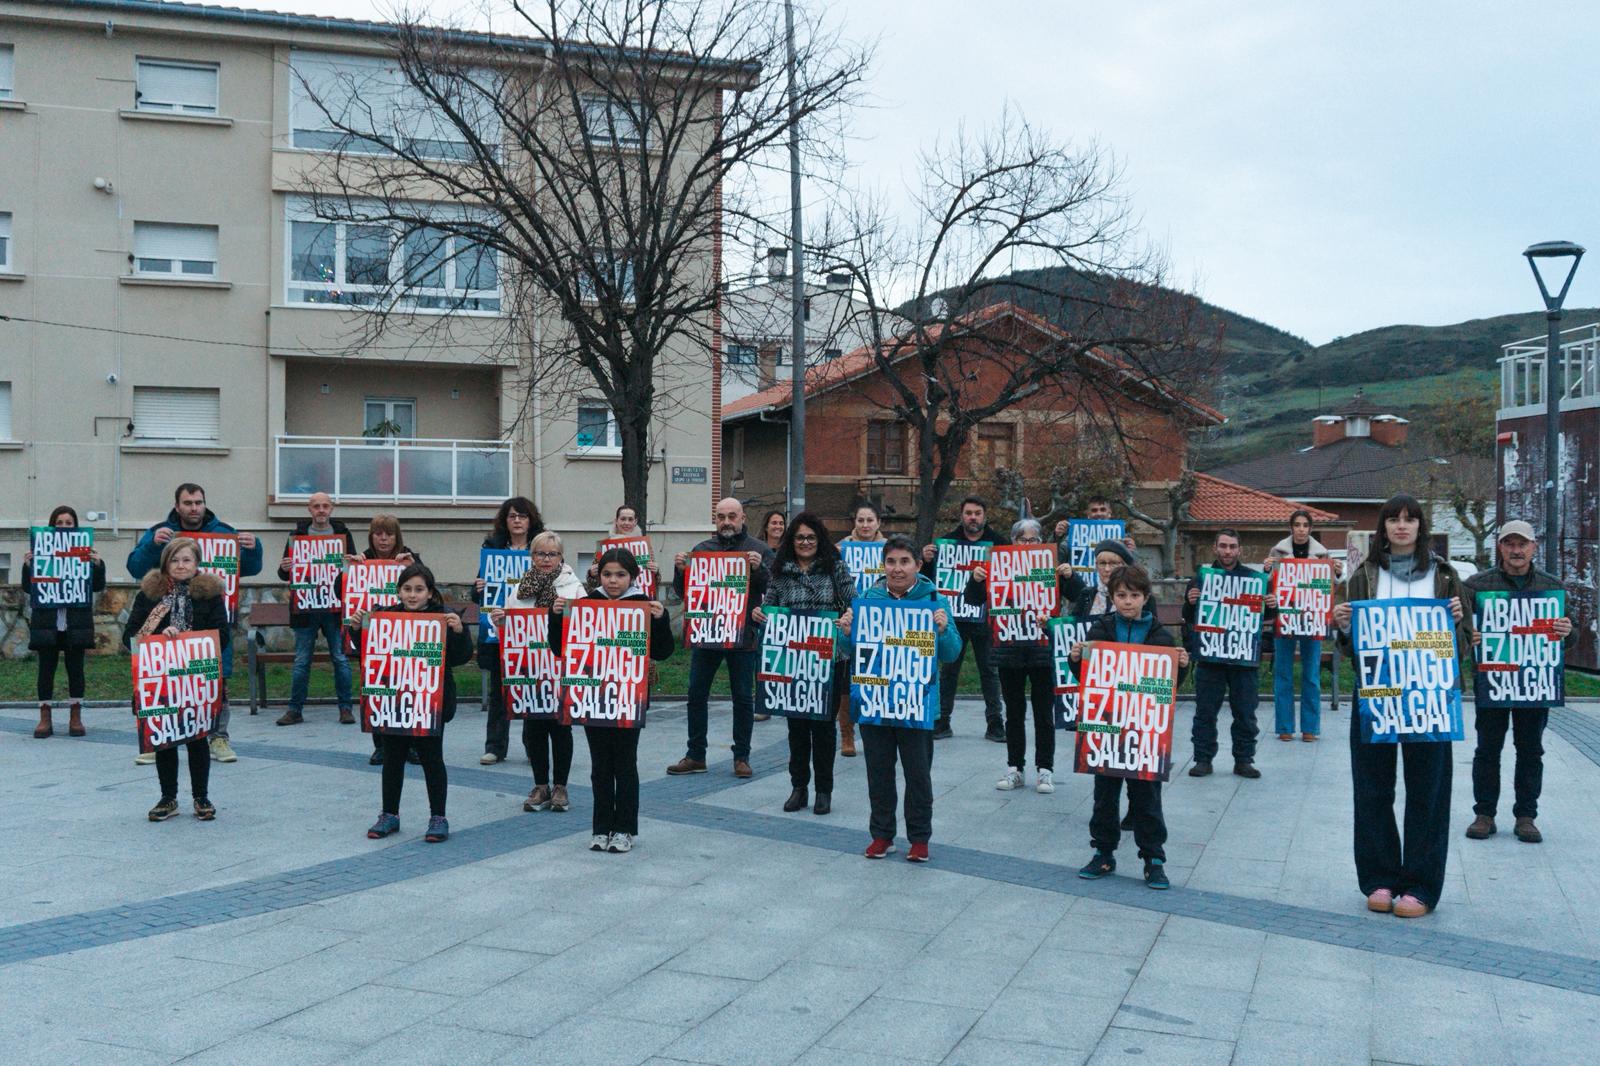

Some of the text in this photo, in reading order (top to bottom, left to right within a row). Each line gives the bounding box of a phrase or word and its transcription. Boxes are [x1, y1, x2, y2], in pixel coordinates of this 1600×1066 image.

[34, 531, 90, 556] ABANTO
[293, 539, 343, 564] ABANTO
[1071, 546, 1087, 568] EZ
[34, 555, 52, 578] EZ
[292, 563, 309, 585] EZ
[689, 558, 747, 586] ABANTO
[936, 567, 953, 591] EZ
[991, 549, 1053, 581] ABANTO
[1279, 563, 1331, 587] ABANTO
[37, 579, 86, 604] SALGAI
[484, 582, 502, 608] EZ
[687, 586, 706, 613] EZ
[990, 581, 1011, 610] EZ
[1200, 573, 1263, 601] ABANTO
[1277, 587, 1296, 609] EZ
[568, 606, 645, 643] ABANTO
[690, 614, 738, 643] SALGAI
[856, 606, 934, 643] ABANTO
[1198, 600, 1218, 626] EZ
[1280, 611, 1327, 636] SALGAI
[1358, 606, 1448, 649] ABANTO
[1481, 597, 1560, 633] ABANTO
[366, 618, 442, 655] ABANTO
[763, 613, 832, 647] ABANTO
[905, 631, 935, 640] 2025.12.19
[1200, 630, 1253, 661] SALGAI
[1391, 640, 1454, 649] MARIA AUXILIADORA
[1415, 632, 1452, 641] 2025.12.19
[138, 637, 216, 677] ABANTO
[504, 648, 525, 679] EZ
[566, 643, 590, 679] EZ
[761, 644, 783, 676] EZ
[855, 643, 878, 677] EZ
[1435, 649, 1454, 658] 19:00
[1481, 632, 1506, 665] EZ
[365, 654, 387, 688] EZ
[1085, 648, 1172, 688] ABANTO
[1359, 649, 1387, 689] EZ
[1487, 666, 1556, 701] SALGAI
[139, 677, 165, 711] EZ
[369, 691, 432, 729] SALGAI
[570, 682, 637, 721] SALGAI
[764, 680, 823, 714] SALGAI
[860, 682, 924, 721] SALGAI
[1082, 687, 1110, 726] EZ
[148, 703, 213, 746] SALGAI
[1369, 690, 1450, 734] SALGAI
[1087, 729, 1159, 773] SALGAI
